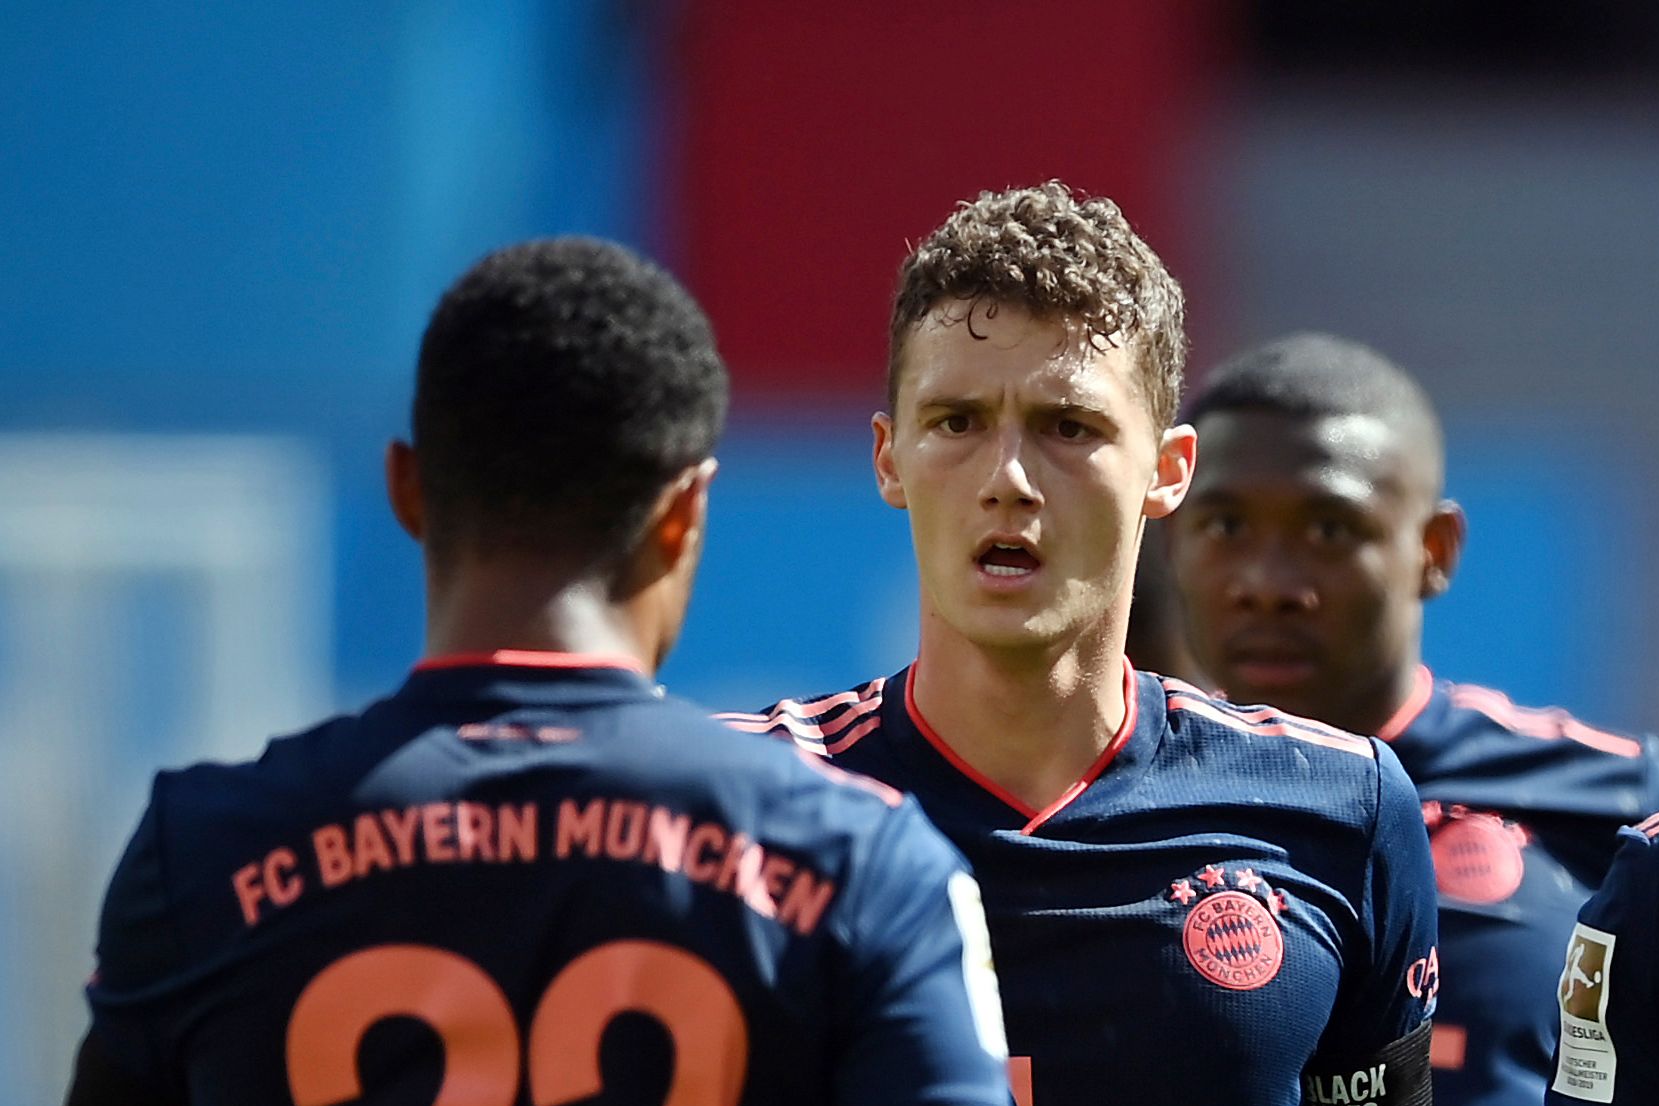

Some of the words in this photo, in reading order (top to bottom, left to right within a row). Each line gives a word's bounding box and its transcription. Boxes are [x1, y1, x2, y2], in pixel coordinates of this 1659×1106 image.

[232, 848, 303, 926] FC
[312, 800, 539, 888] BAYERN
[1193, 911, 1211, 931] FC
